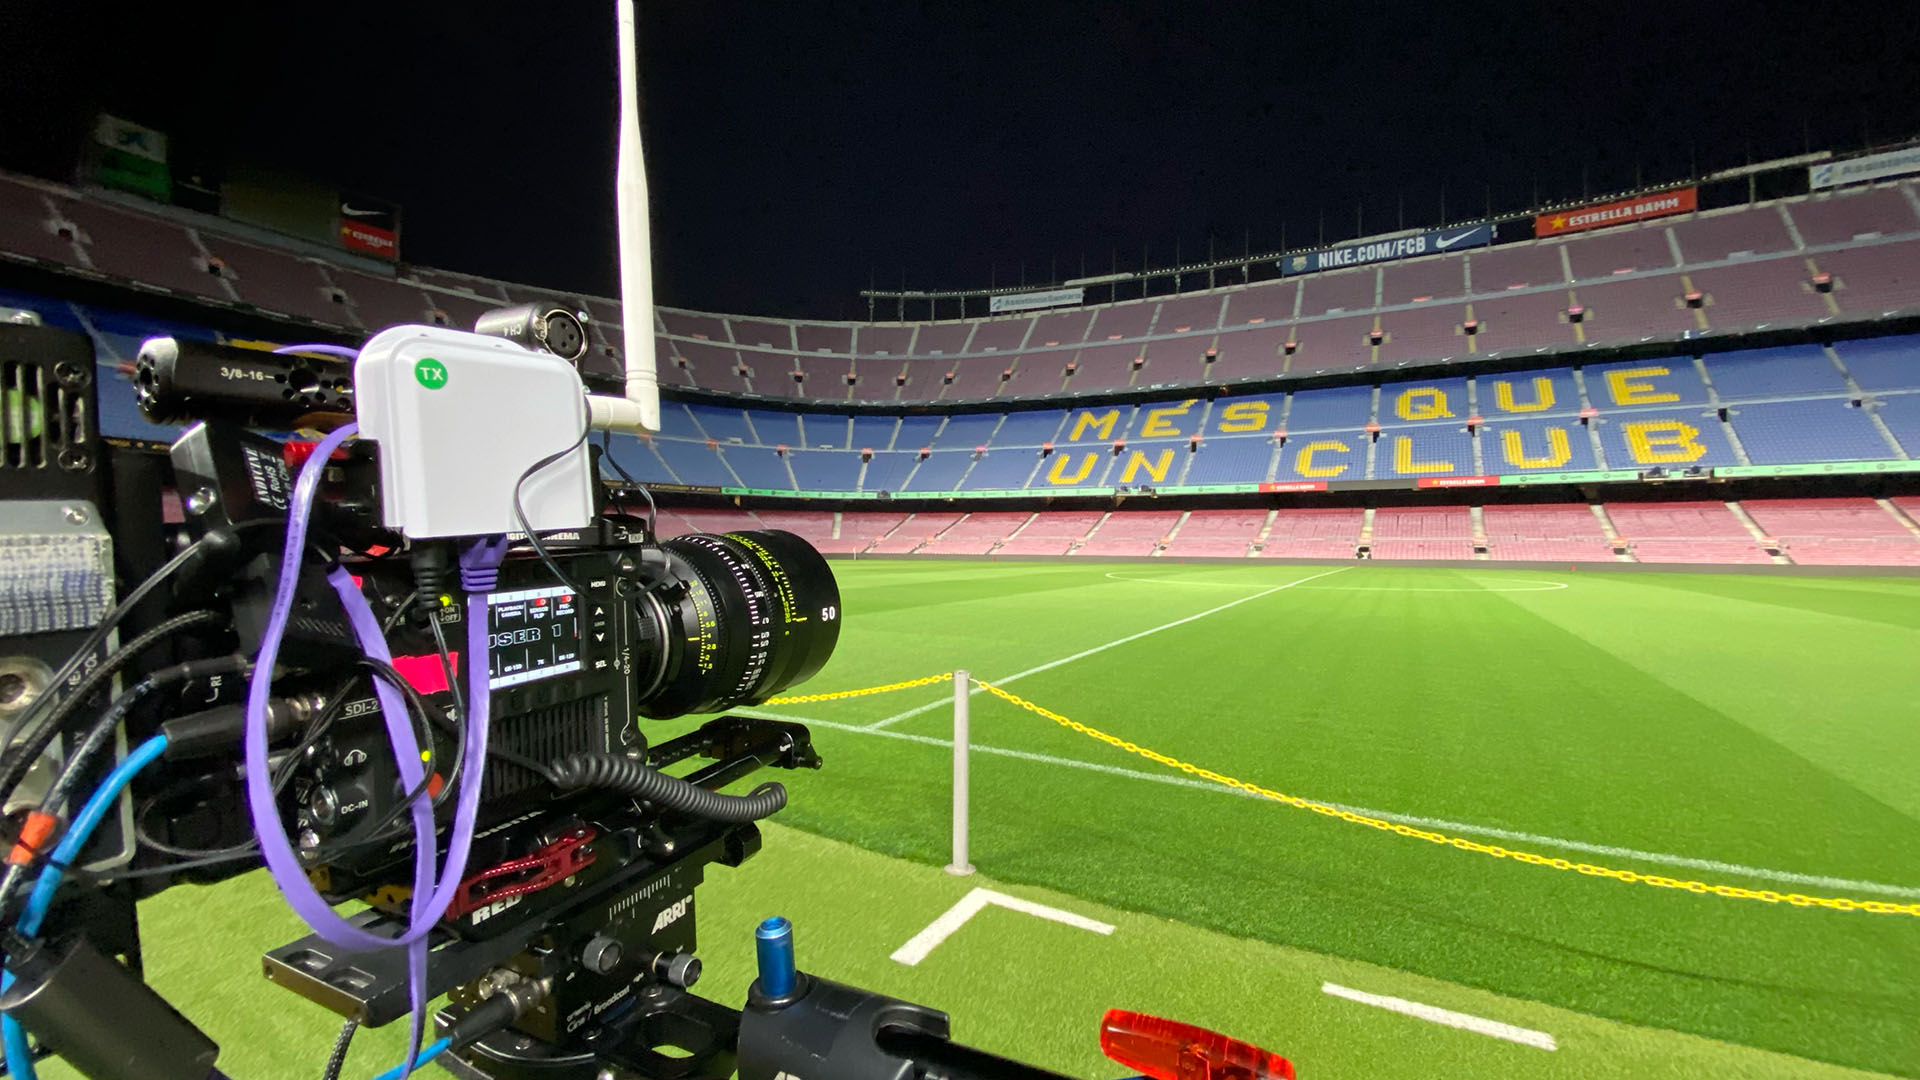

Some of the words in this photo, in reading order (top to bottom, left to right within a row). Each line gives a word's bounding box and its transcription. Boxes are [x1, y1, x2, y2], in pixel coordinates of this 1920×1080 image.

[1569, 206, 1632, 226] ESTRELLA
[1635, 197, 1679, 215] DAMM
[1318, 236, 1427, 268] NIKE.COM/FCB
[220, 366, 265, 382] 3/8-16
[419, 366, 444, 382] TX
[1068, 398, 1271, 442] MÉS
[1394, 366, 1682, 422] QUE
[1047, 447, 1177, 486] UN
[1295, 420, 1709, 477] CLUB
[821, 606, 836, 621] 50
[551, 623, 562, 638] 1
[621, 647, 631, 675] 1/4-20
[345, 700, 380, 716] SDI-2
[341, 799, 369, 815] DC-IN
[651, 896, 688, 936] ARRI
